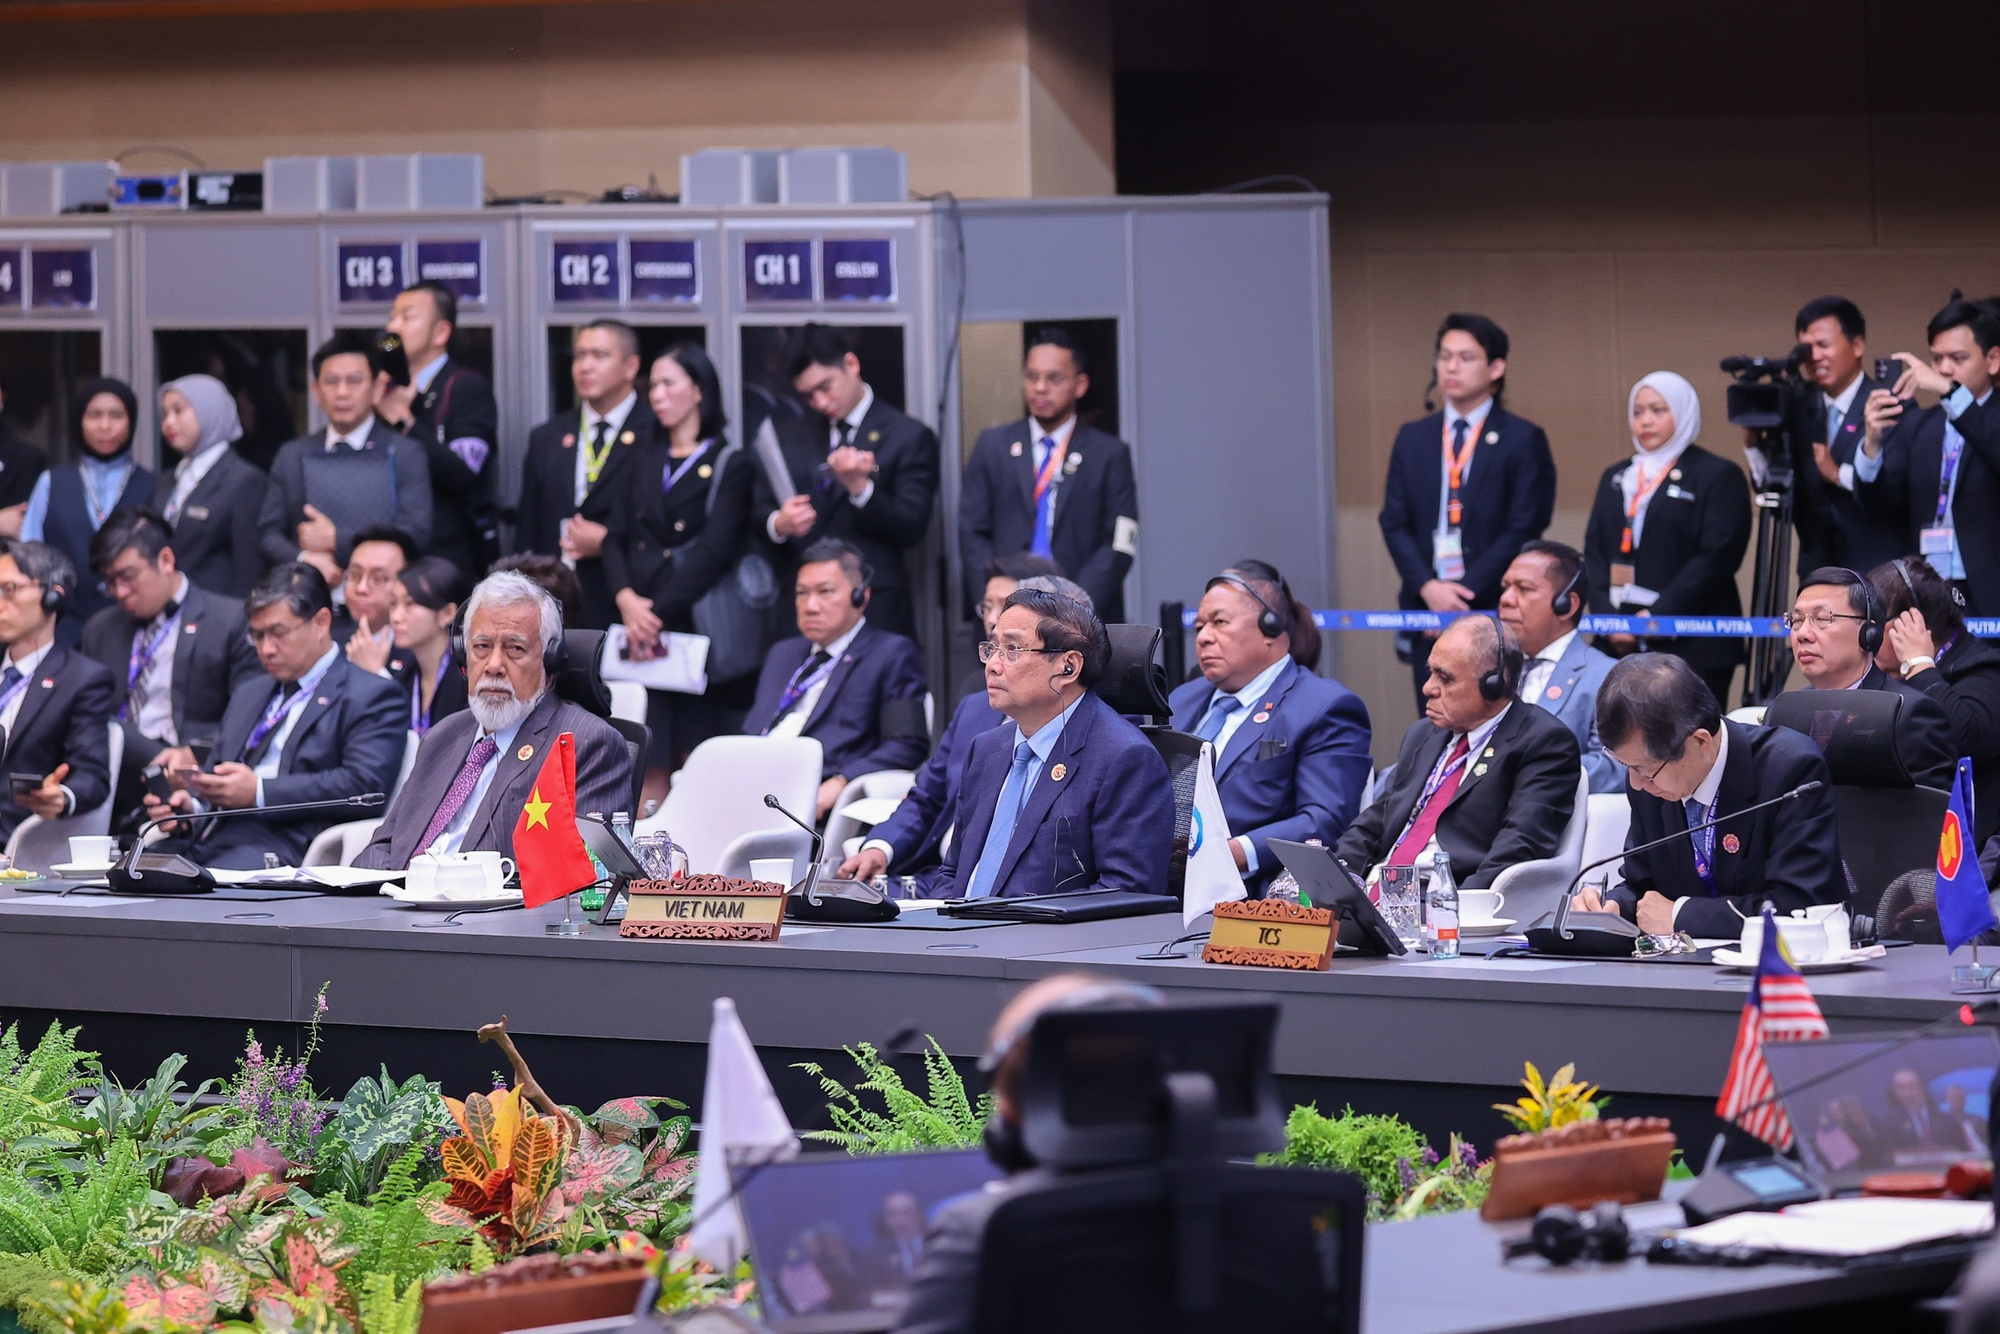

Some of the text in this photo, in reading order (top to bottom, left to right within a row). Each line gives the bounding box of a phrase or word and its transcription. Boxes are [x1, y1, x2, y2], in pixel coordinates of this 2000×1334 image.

[0, 261, 13, 292] 4
[345, 256, 394, 287] CH 3
[560, 254, 610, 286] CH 2
[754, 254, 800, 285] CH 1
[1365, 613, 1441, 628] WISMA PUTRA
[1593, 617, 1630, 632] PUTRA
[1674, 619, 1753, 633] WISMA PUTRA
[665, 900, 745, 919] VIET NAM
[1258, 926, 1282, 945] TCS
